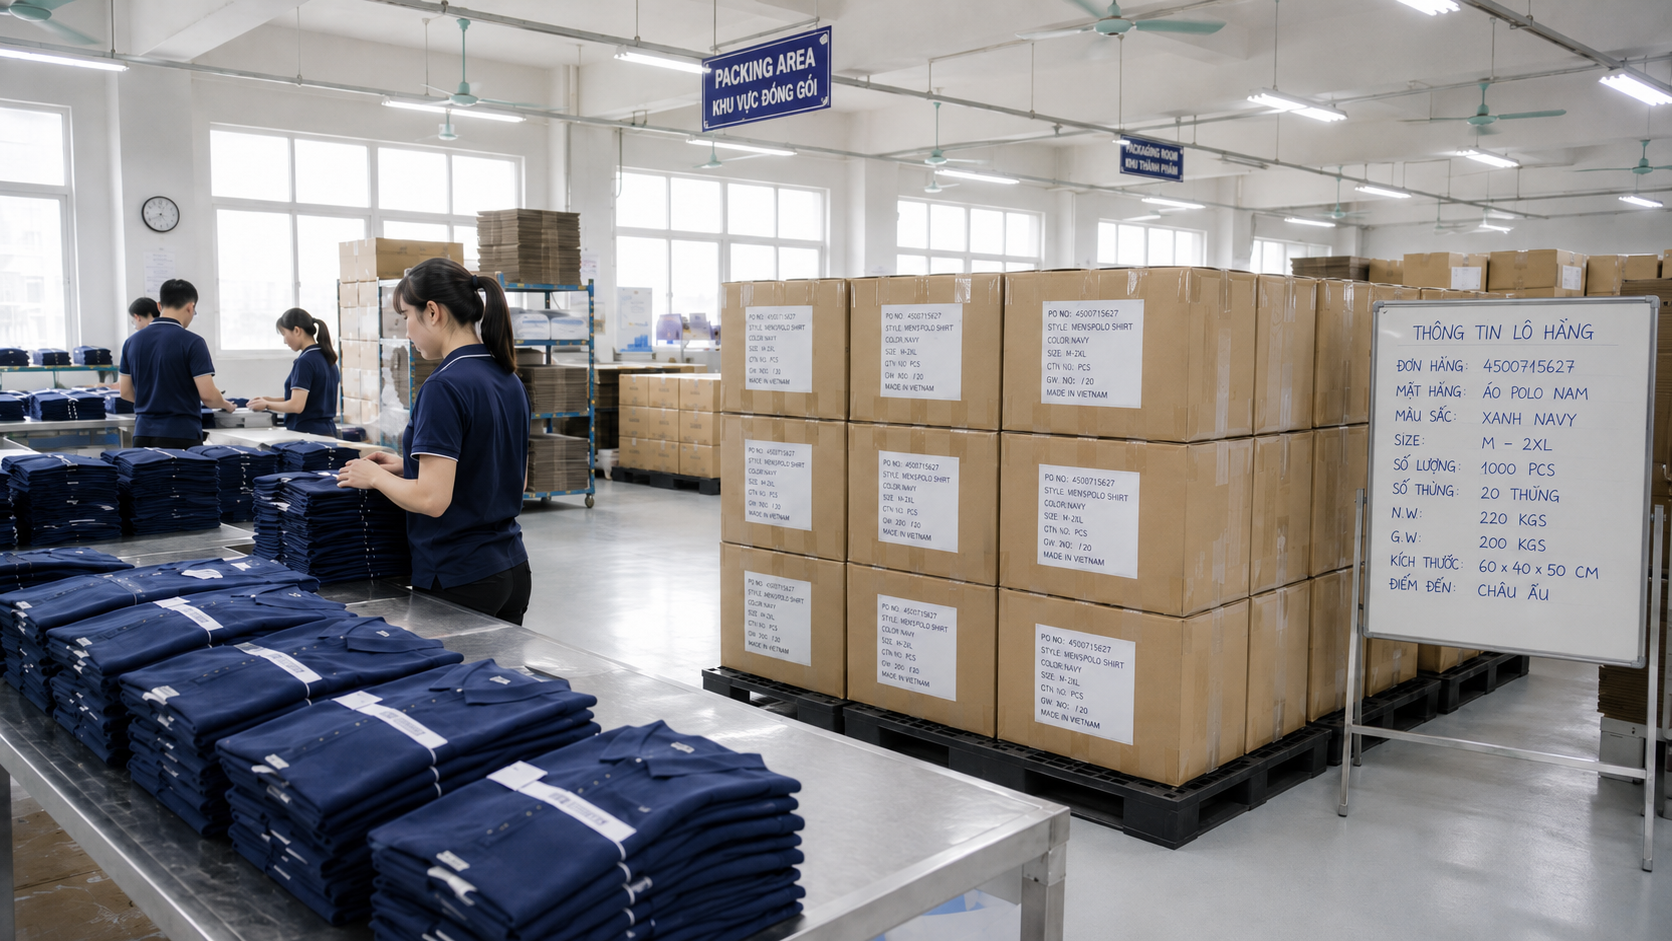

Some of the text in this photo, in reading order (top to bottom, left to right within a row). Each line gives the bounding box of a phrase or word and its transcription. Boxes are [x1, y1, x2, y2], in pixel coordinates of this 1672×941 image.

[715, 47, 816, 89] PACKING AREA
[712, 74, 818, 116] KHU VỰC ĐÓNG GÓI
[1048, 310, 1057, 318] PO
[1076, 309, 1118, 318] 4500715627
[1413, 320, 1464, 340] THÔNG
[1475, 324, 1502, 340] TIN
[1513, 319, 1533, 340] LÔ
[1078, 363, 1091, 371] PCS
[1396, 358, 1422, 372] ĐƠN
[1483, 359, 1575, 373] 4500715627
[1046, 389, 1065, 397] MADE
[1077, 390, 1107, 398] VIETNAM
[1511, 386, 1543, 399] POLO
[1553, 387, 1588, 400] NAM
[1482, 411, 1521, 425] XANH
[1534, 413, 1577, 427] NAVY
[1482, 437, 1495, 449] M
[1522, 438, 1552, 451] 2XL
[1394, 454, 1411, 471] SỐ
[1481, 461, 1516, 475] 1000
[1529, 462, 1555, 477] PCS
[1045, 473, 1115, 487] PO NO: 4500715627
[1393, 478, 1410, 495] SỐ
[1481, 486, 1500, 499] 20
[1107, 492, 1128, 501] SHIRT
[1480, 511, 1507, 525] 220
[1519, 513, 1547, 527] KGS
[1074, 529, 1087, 537] PCS
[1479, 536, 1507, 549] 200
[1518, 538, 1546, 552] KGS
[1043, 551, 1062, 560] MADE
[1074, 555, 1104, 565] VIETNAM
[1391, 550, 1416, 568] KÍCH
[1479, 556, 1497, 573] 60
[1512, 561, 1531, 575] 40
[1547, 564, 1566, 576] 50
[1575, 566, 1599, 579] CM
[1477, 580, 1518, 597] CHÂU
[1041, 633, 1050, 642] PO
[1052, 636, 1065, 644] NO:
[1103, 659, 1124, 669] SHIRT
[1070, 690, 1083, 700] PCS
[1041, 709, 1059, 719] MADE
[1070, 716, 1100, 729] VIETNAM
